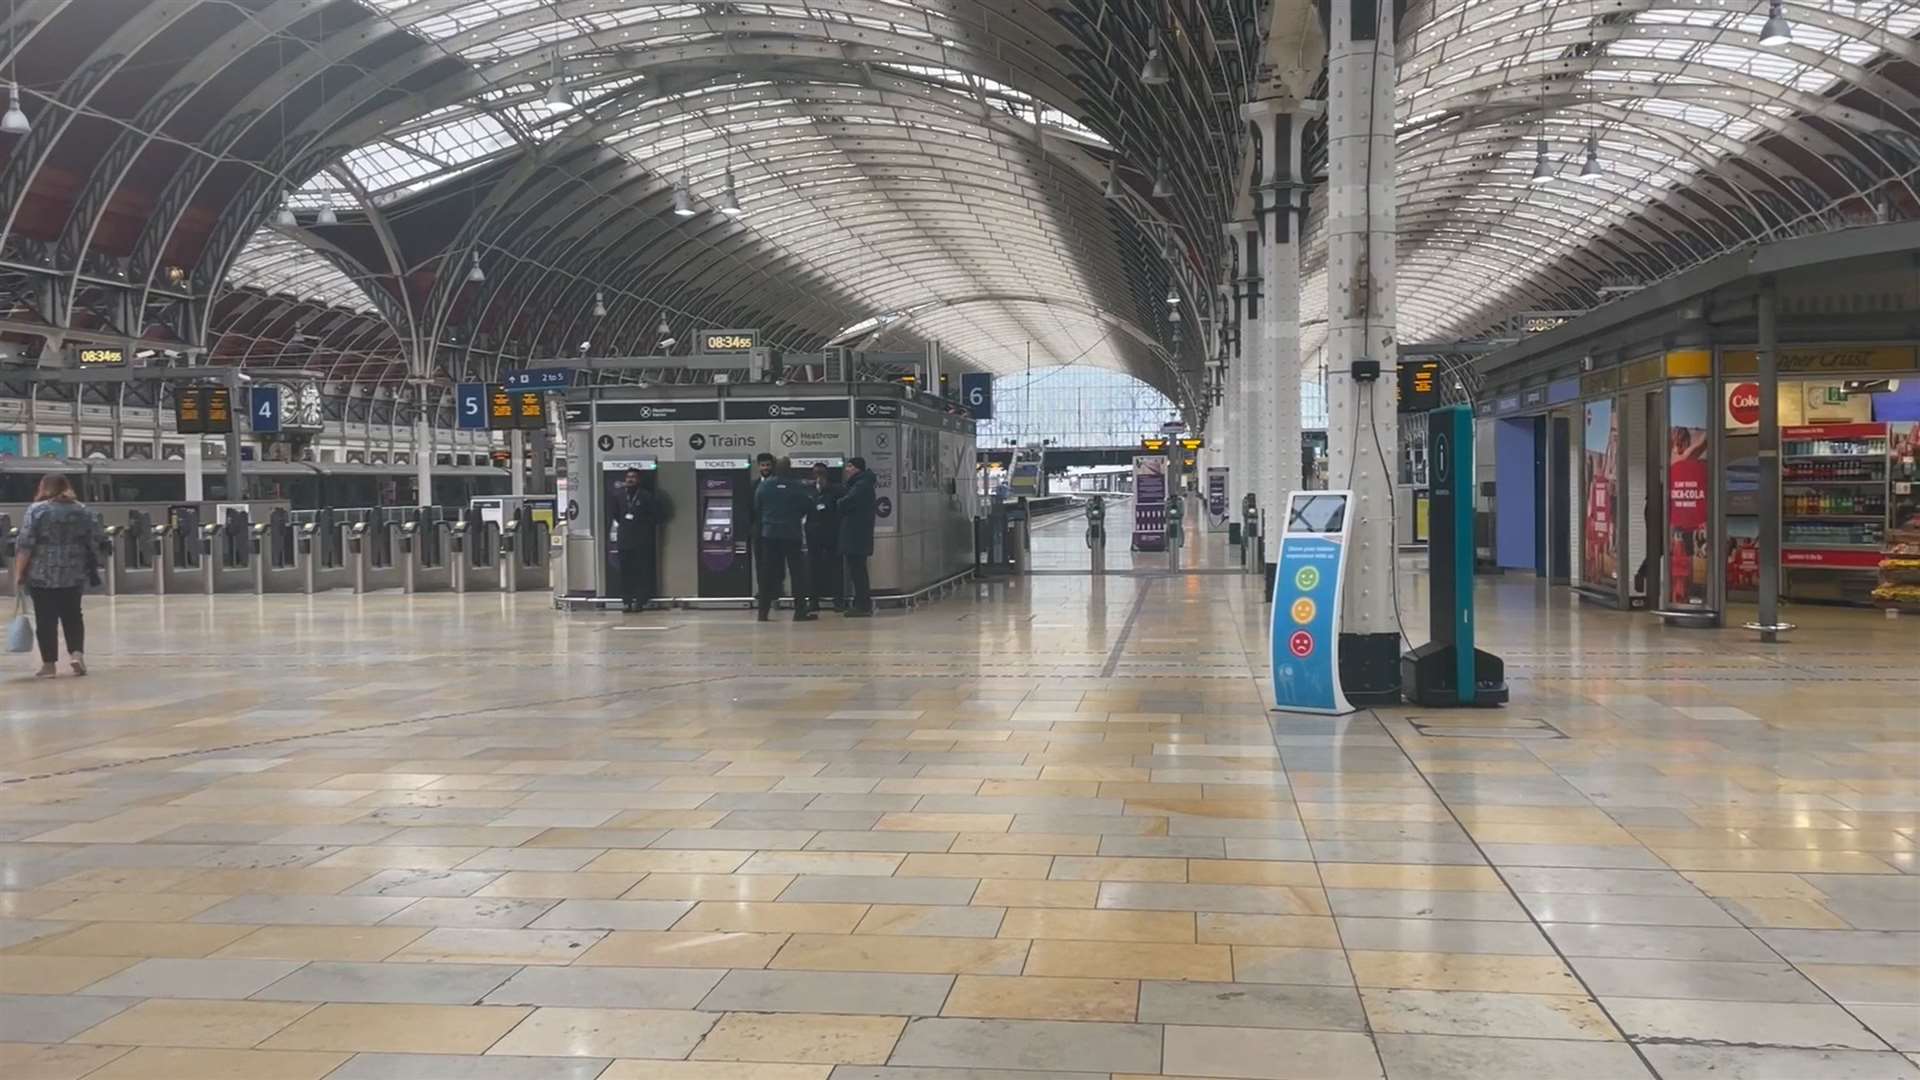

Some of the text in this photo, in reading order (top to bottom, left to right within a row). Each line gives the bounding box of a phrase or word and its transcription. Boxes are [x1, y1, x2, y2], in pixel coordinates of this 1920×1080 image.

[970, 387, 983, 406] 6
[259, 402, 272, 418] 4
[465, 396, 478, 416] 5
[618, 435, 674, 449] Tickets
[709, 434, 756, 447] Trains
[800, 431, 840, 440] Heathrow
[704, 460, 736, 468] TICKETS
